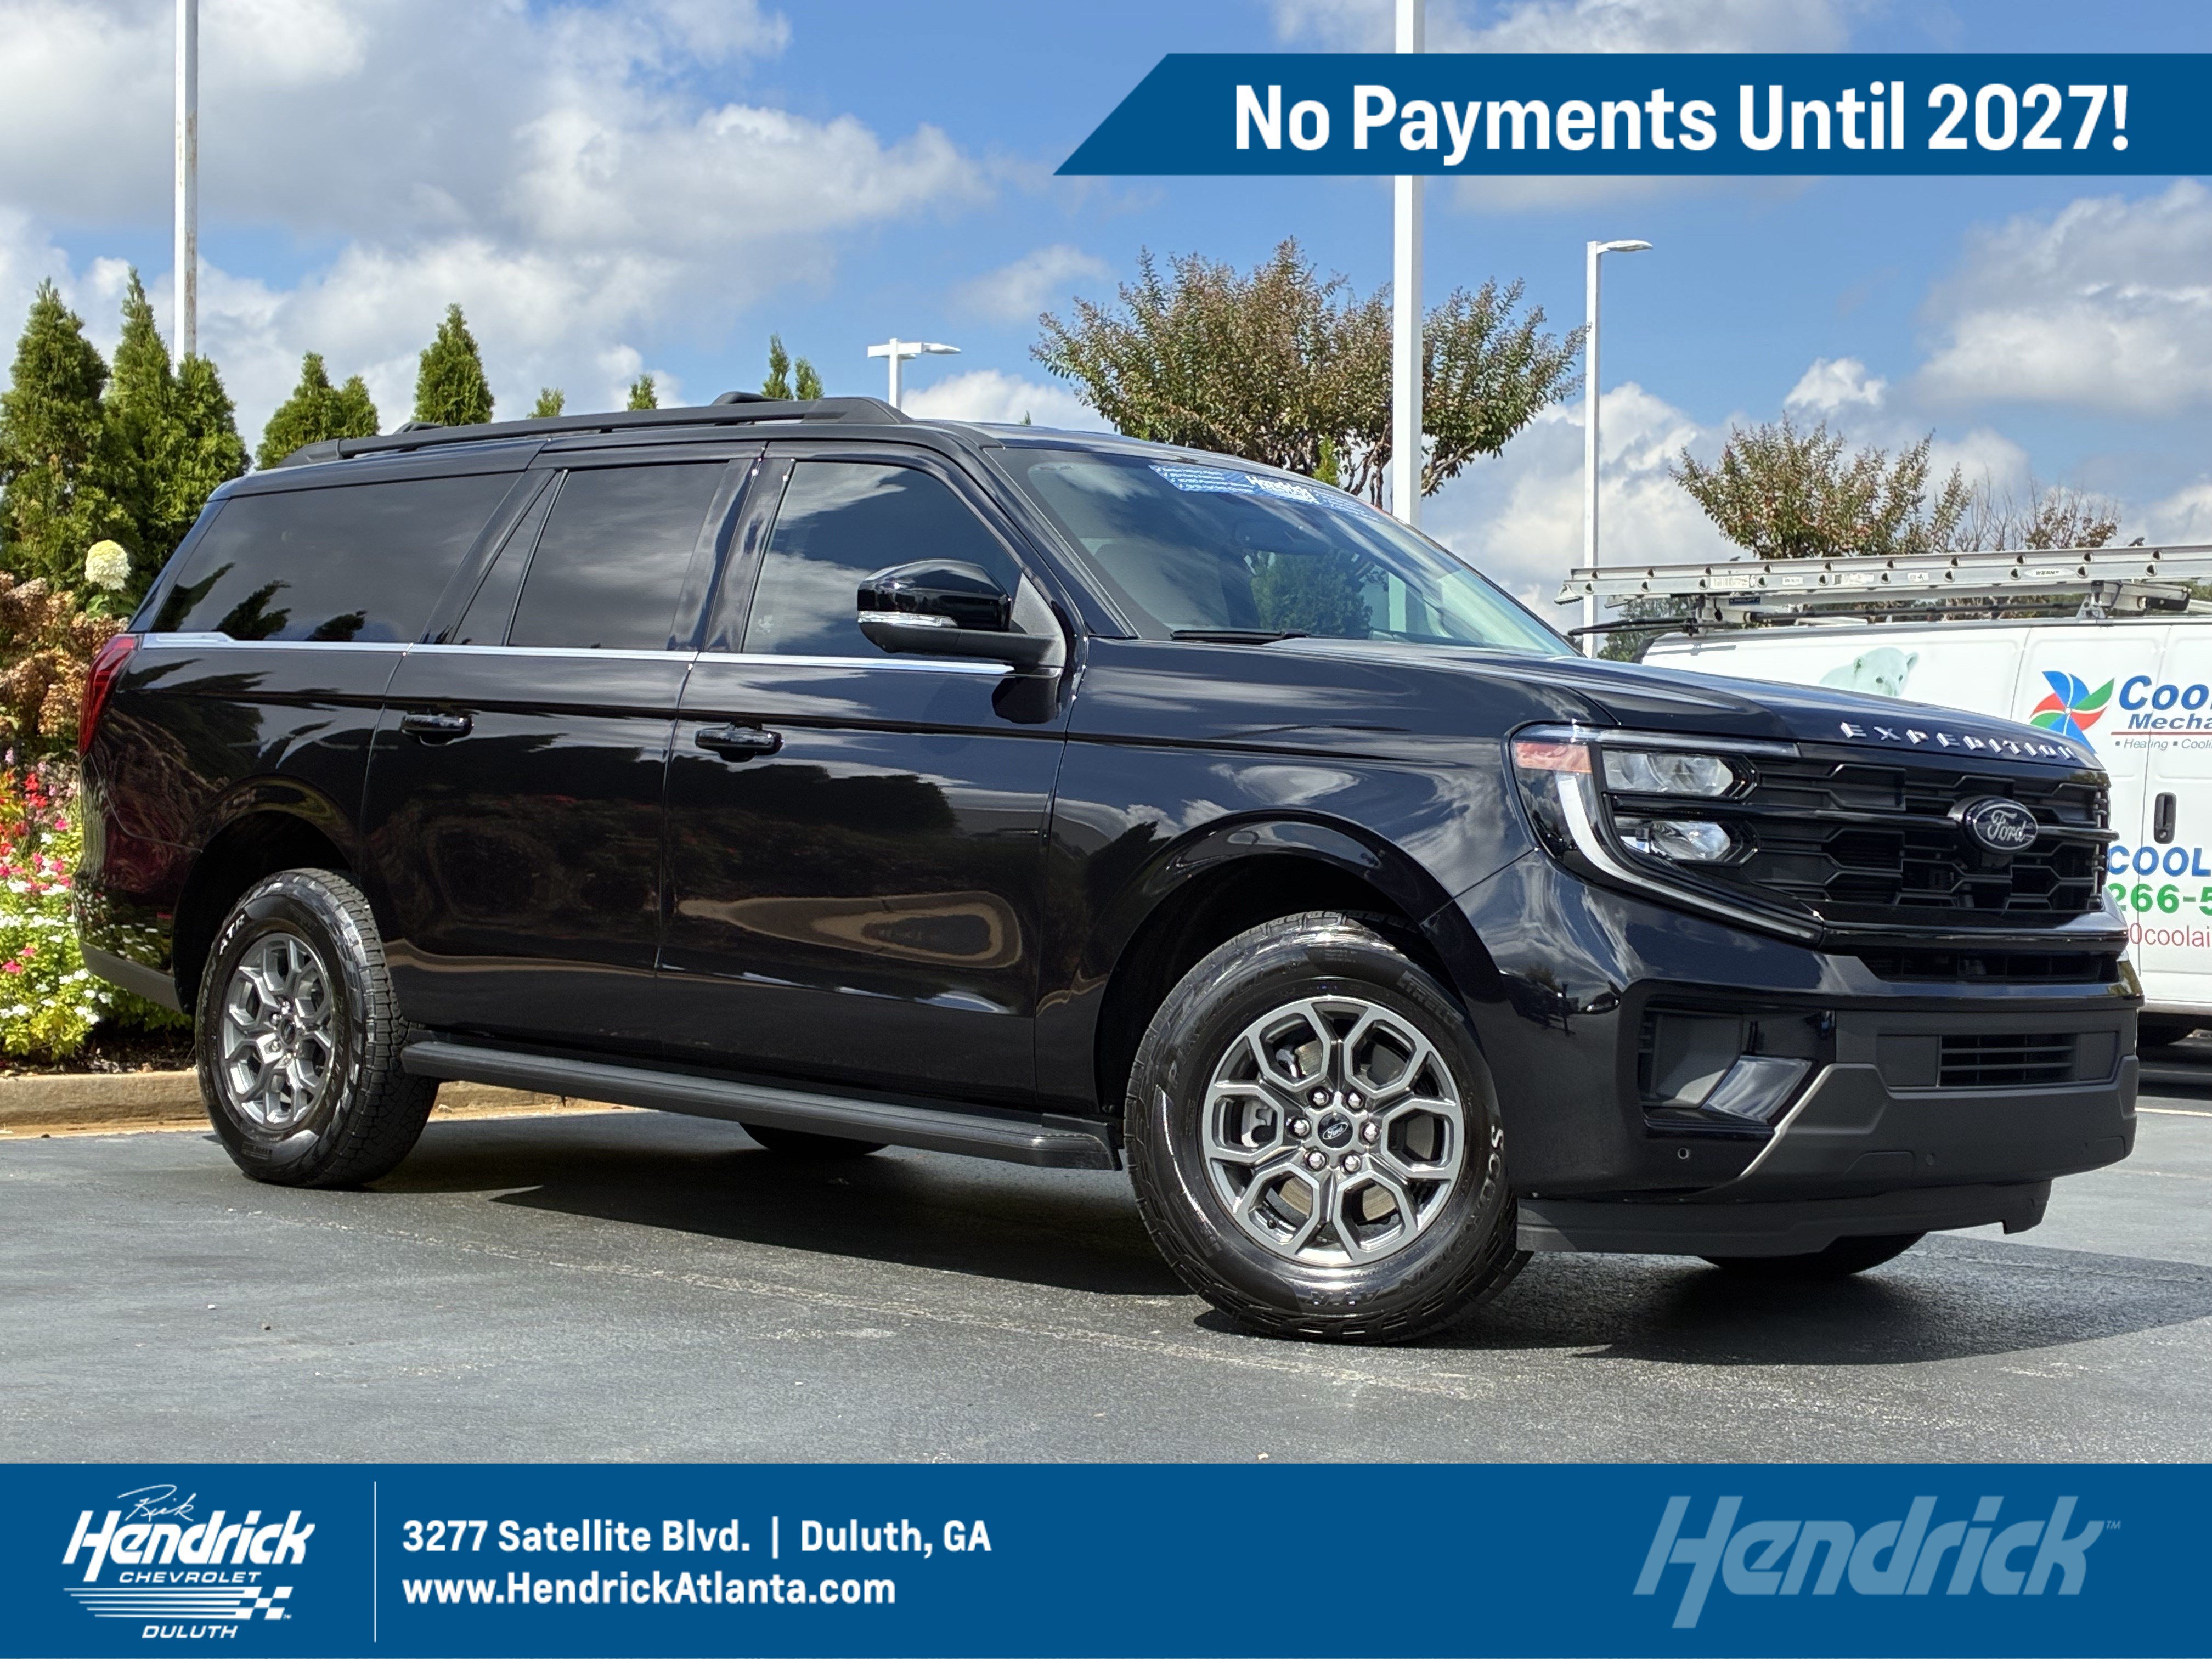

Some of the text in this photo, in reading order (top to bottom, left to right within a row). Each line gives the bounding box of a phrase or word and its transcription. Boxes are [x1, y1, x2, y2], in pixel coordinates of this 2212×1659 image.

[2119, 675, 2212, 710] Coo
[1840, 721, 2079, 760] EXPEDITION
[2181, 738, 2212, 749] Cooli
[1987, 810, 2027, 842] Ford
[2108, 845, 2211, 877] COOL
